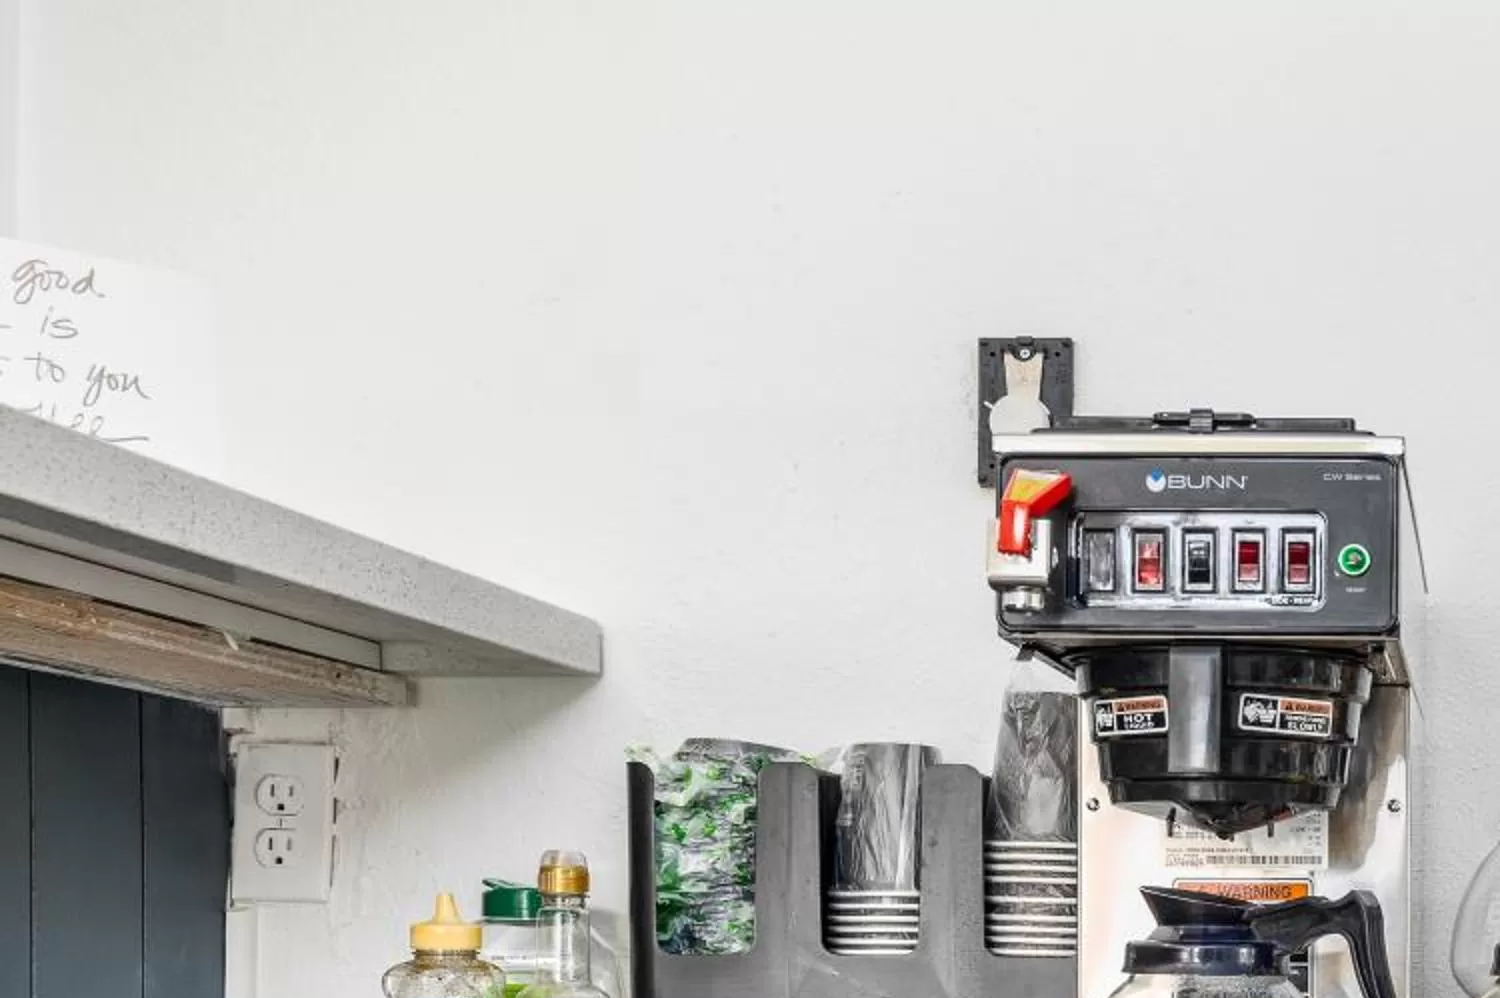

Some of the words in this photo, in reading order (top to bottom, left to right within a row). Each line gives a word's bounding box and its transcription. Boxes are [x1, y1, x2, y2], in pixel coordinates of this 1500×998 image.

[40, 305, 79, 339] is
[24, 352, 65, 382] to
[83, 364, 153, 407] you
[1167, 474, 1246, 490] BUNN
[1123, 713, 1154, 723] HOT
[1217, 884, 1292, 900] WARNING
